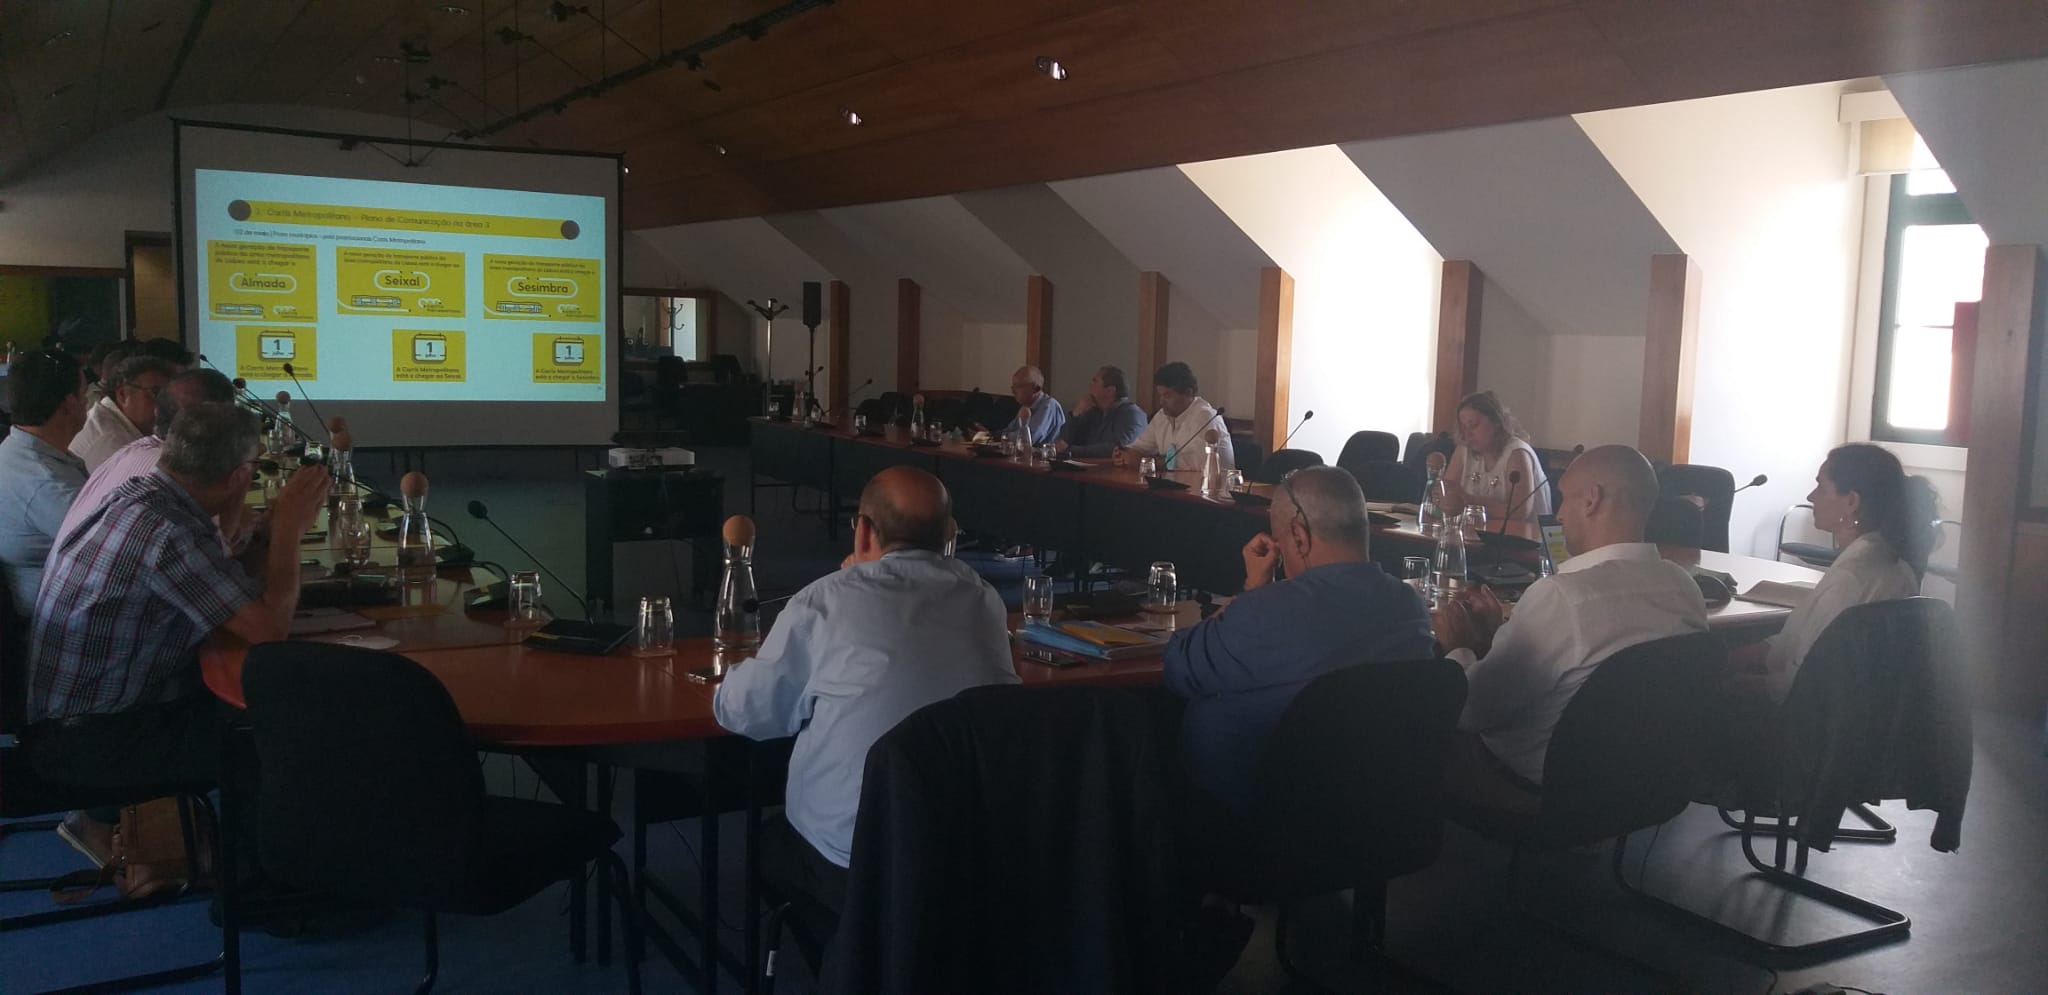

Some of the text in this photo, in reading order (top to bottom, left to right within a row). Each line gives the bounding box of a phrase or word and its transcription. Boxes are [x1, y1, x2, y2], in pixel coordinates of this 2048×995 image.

[361, 213, 383, 222] Plano
[384, 215, 395, 223] de
[398, 216, 453, 227] Comunicação
[241, 277, 286, 289] Almada
[385, 275, 420, 287] Seixal
[518, 281, 569, 293] Sesimbra
[273, 339, 280, 351] 1
[426, 341, 433, 353] 1
[565, 344, 572, 356] 1
